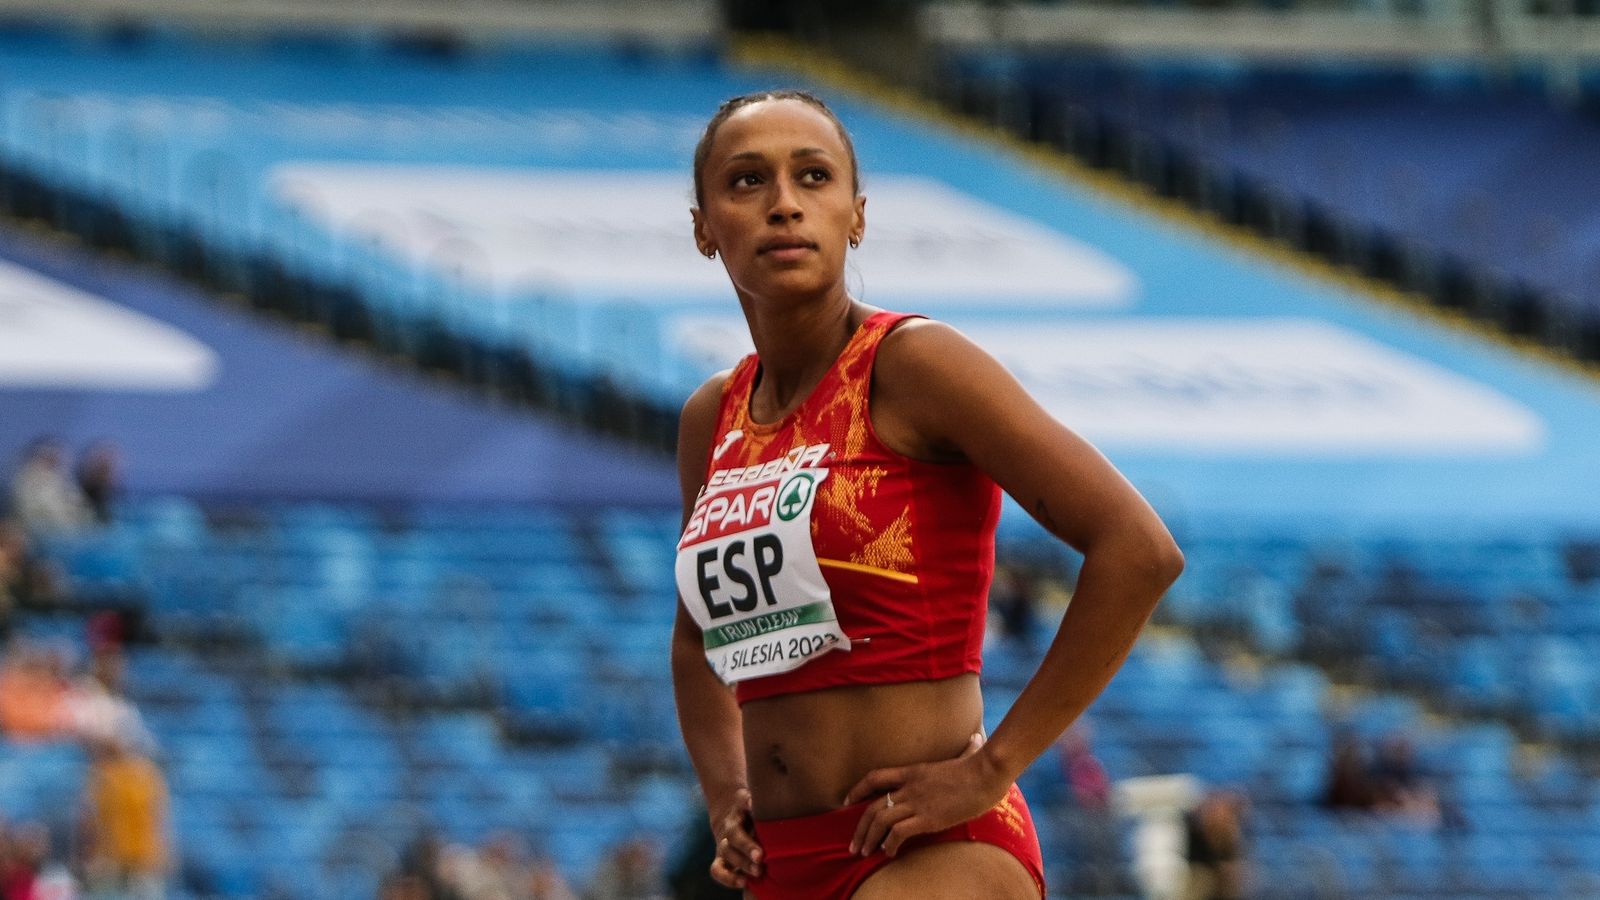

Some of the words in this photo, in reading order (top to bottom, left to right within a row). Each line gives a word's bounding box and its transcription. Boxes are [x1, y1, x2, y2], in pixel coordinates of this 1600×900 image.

[682, 486, 776, 543] SPAR
[697, 533, 783, 620] ESP
[719, 628, 729, 642] I
[725, 620, 757, 640] RUN
[730, 640, 784, 670] SILESIA
